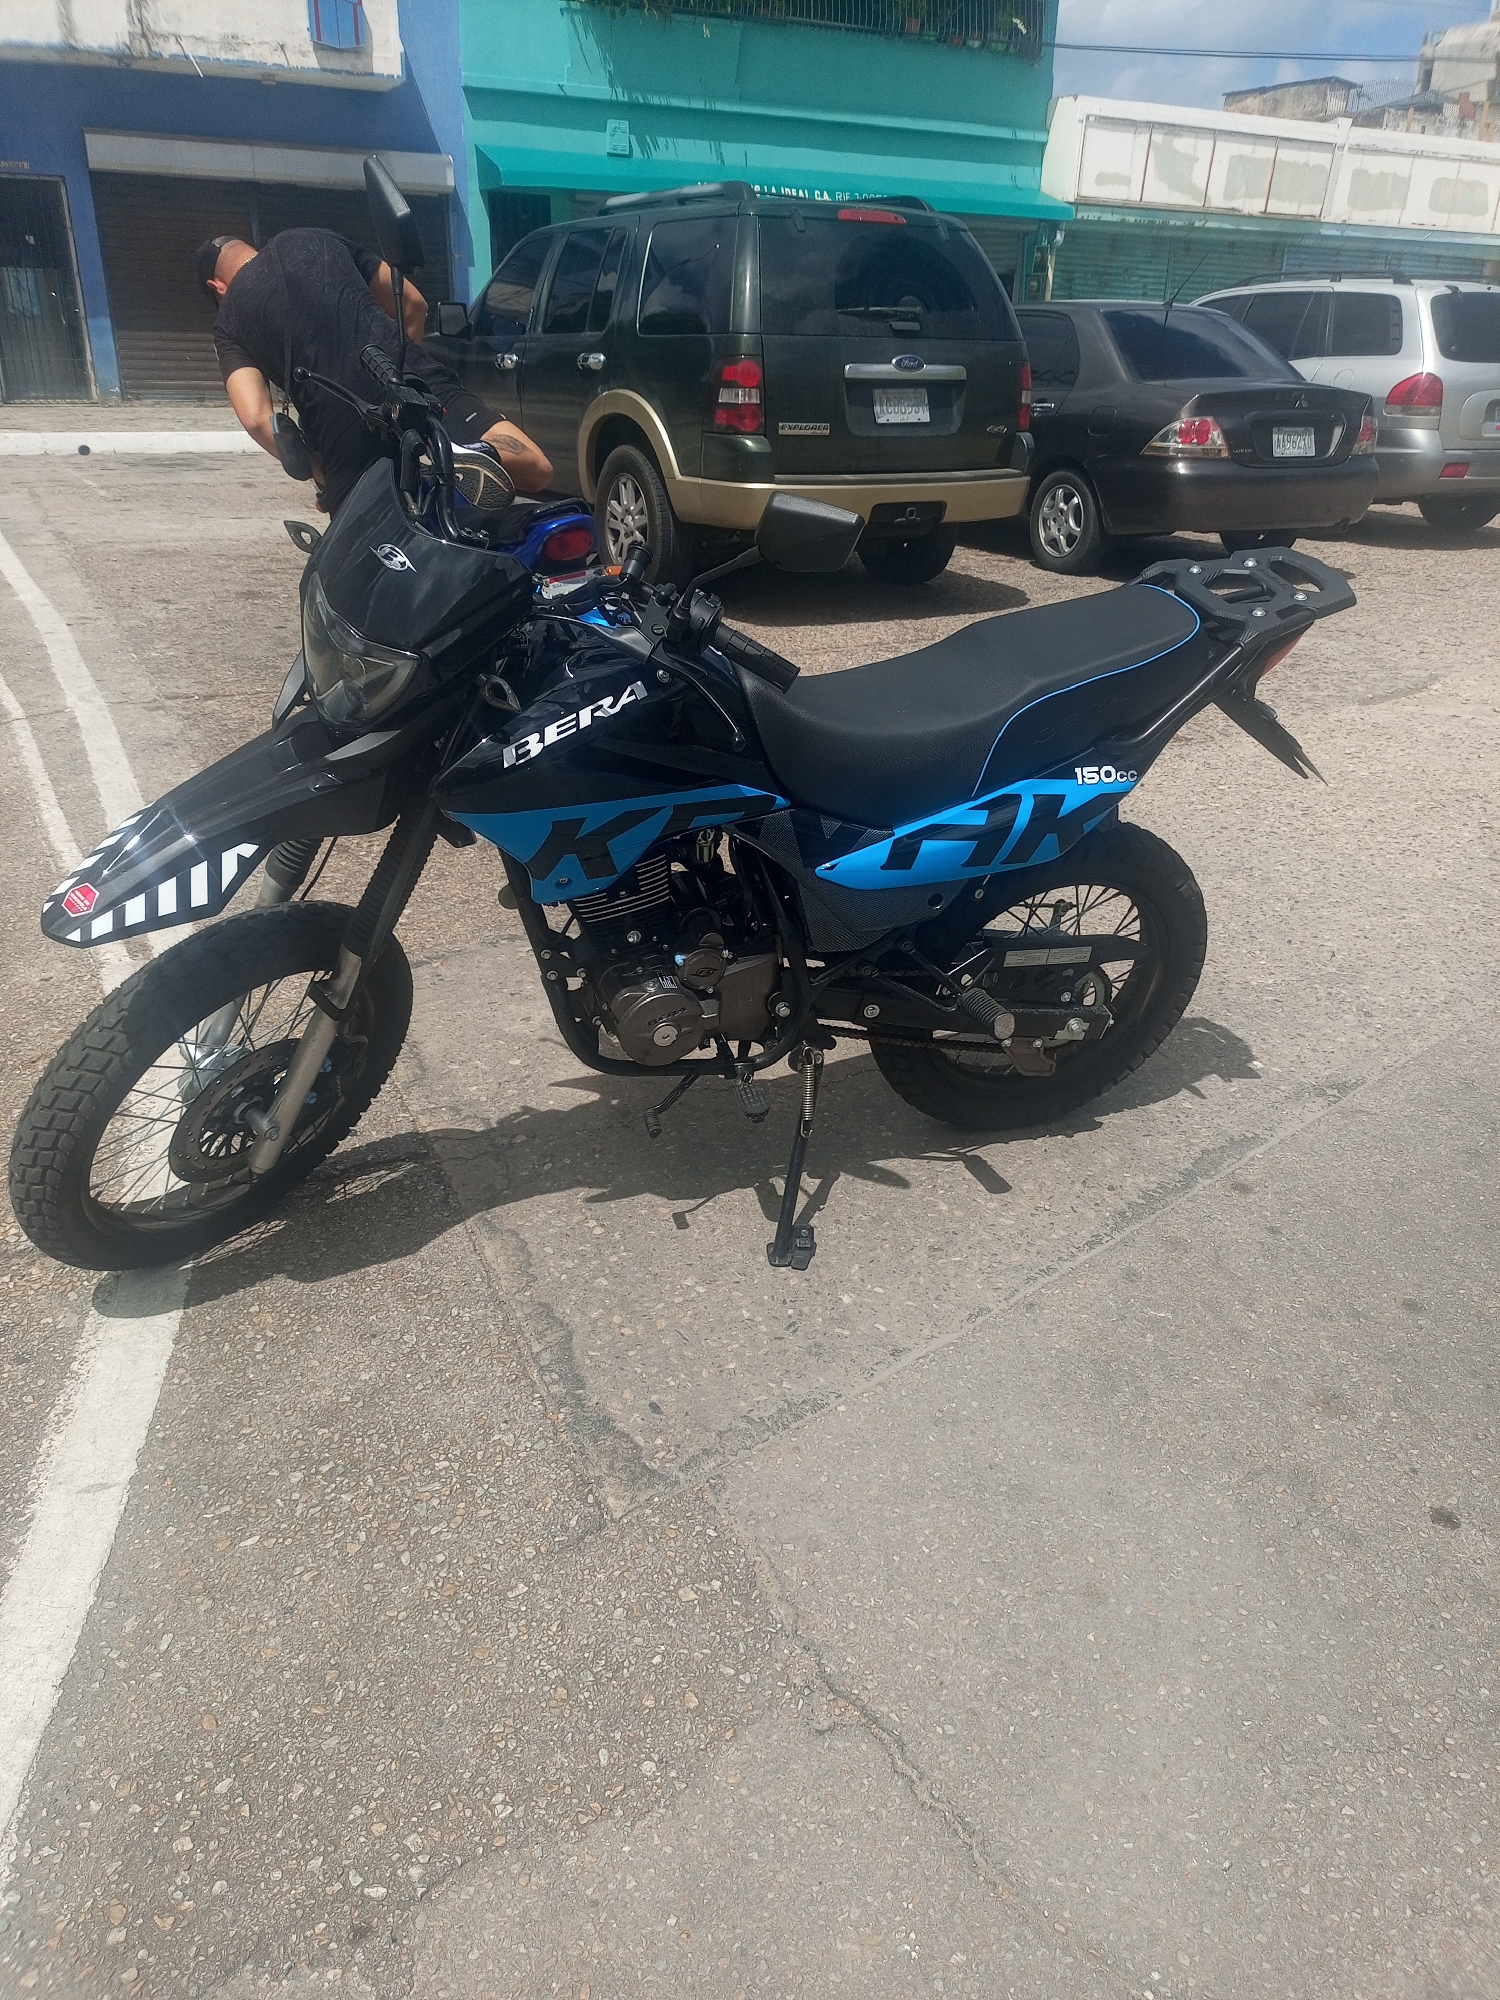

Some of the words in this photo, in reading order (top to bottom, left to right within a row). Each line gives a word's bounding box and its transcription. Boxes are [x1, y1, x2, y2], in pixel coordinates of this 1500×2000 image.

[900, 358, 919, 368] Ford
[779, 423, 829, 431] EXPLORER
[502, 680, 649, 769] BERA
[1074, 765, 1138, 785] 150cc
